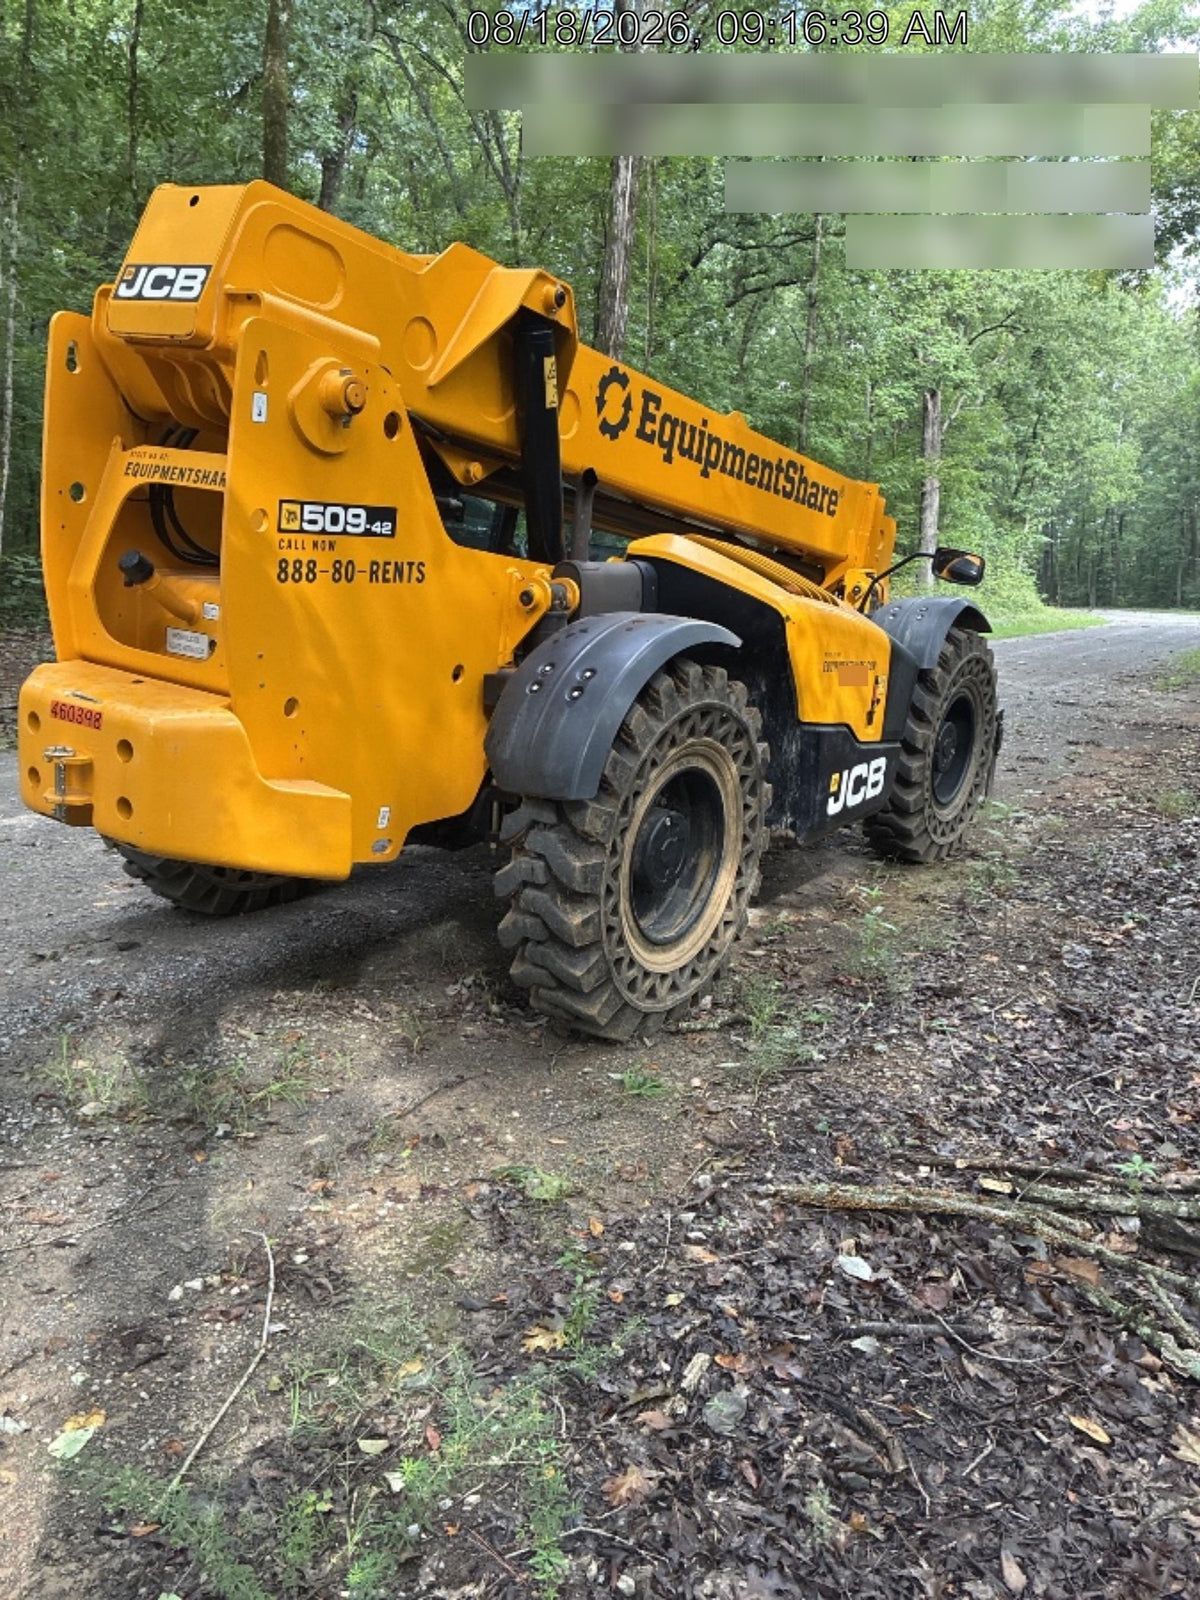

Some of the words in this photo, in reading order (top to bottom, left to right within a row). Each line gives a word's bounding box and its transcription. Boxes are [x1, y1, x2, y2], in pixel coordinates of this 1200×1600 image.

[117, 266, 207, 298] JCB
[635, 389, 839, 518] EquipmentShare
[278, 538, 306, 550] CALL
[312, 540, 337, 551] NOW
[277, 558, 426, 584] 888-80-RENTS
[51, 701, 102, 730] 460398
[827, 757, 887, 815] JCB
